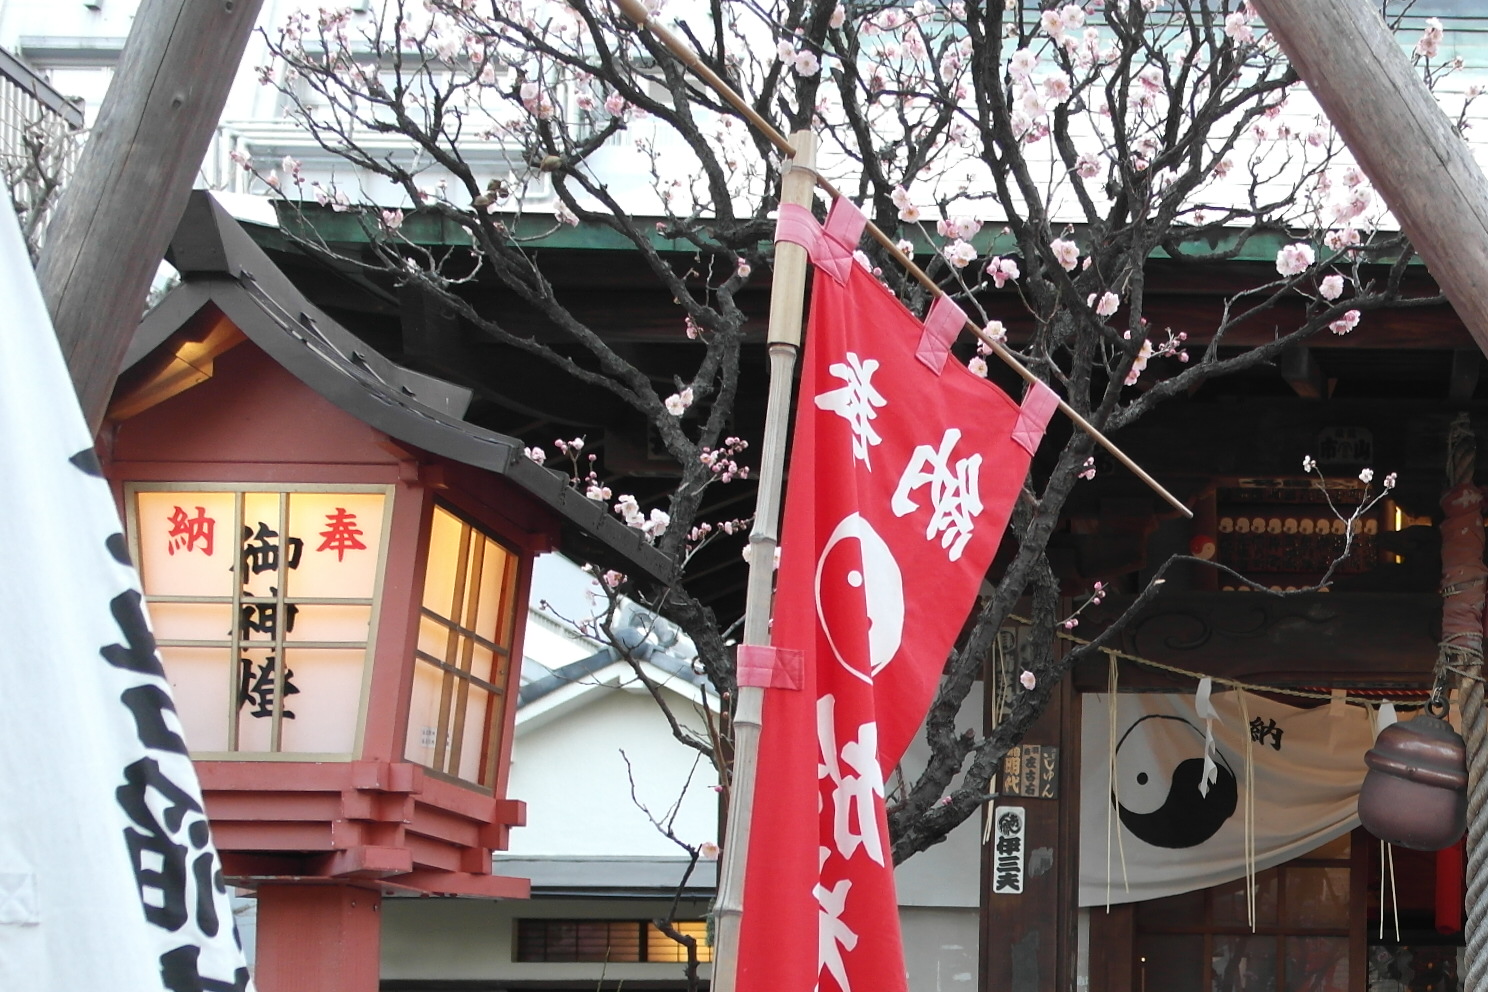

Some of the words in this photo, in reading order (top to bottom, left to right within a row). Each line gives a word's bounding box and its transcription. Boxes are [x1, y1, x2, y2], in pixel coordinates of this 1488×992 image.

[166, 505, 215, 557] 納
[316, 507, 368, 562] 奉
[228, 522, 304, 721] 御神燈
[1250, 715, 1284, 751] 納
